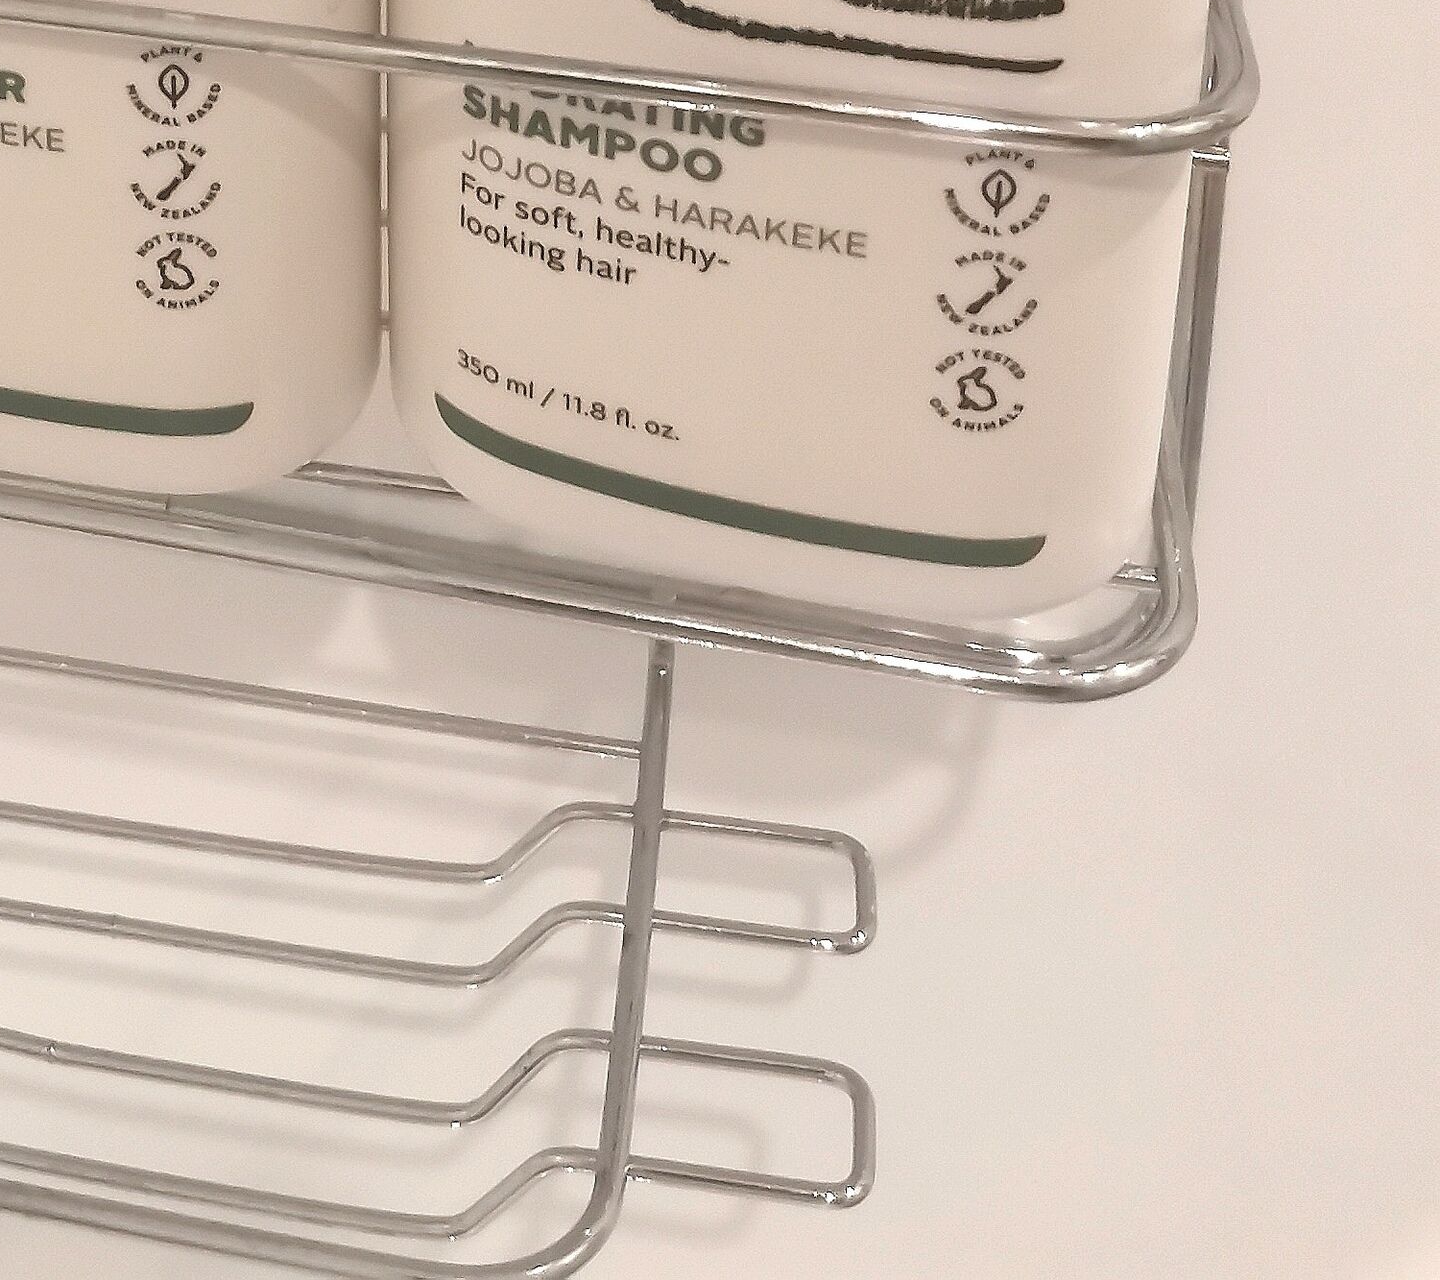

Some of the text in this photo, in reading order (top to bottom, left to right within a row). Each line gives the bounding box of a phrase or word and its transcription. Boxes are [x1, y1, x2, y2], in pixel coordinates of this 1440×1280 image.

[140, 46, 191, 62] PLANT
[126, 83, 221, 127] MINERAL BASED
[142, 139, 207, 158] MADE IN
[462, 83, 723, 182] SHAMPOO
[965, 149, 1023, 166] PLANT
[130, 182, 222, 220] NEW ZEALAND
[461, 138, 869, 259] JOJOBA & HARAKEKE
[1009, 193, 1050, 234] BASED
[461, 172, 732, 273] For soft, healthy-
[136, 231, 218, 258] NOT TESTED
[460, 203, 638, 285] looking hair
[955, 250, 1027, 271] MADE IN
[135, 279, 220, 309] ON ANIMALS
[936, 293, 1038, 336] NEW ZEALAND
[935, 349, 1026, 380] NOT TESTED
[457, 348, 680, 441] 350 ml / 11.8 fl. oz.
[929, 397, 1024, 432] ON ANIMALS
